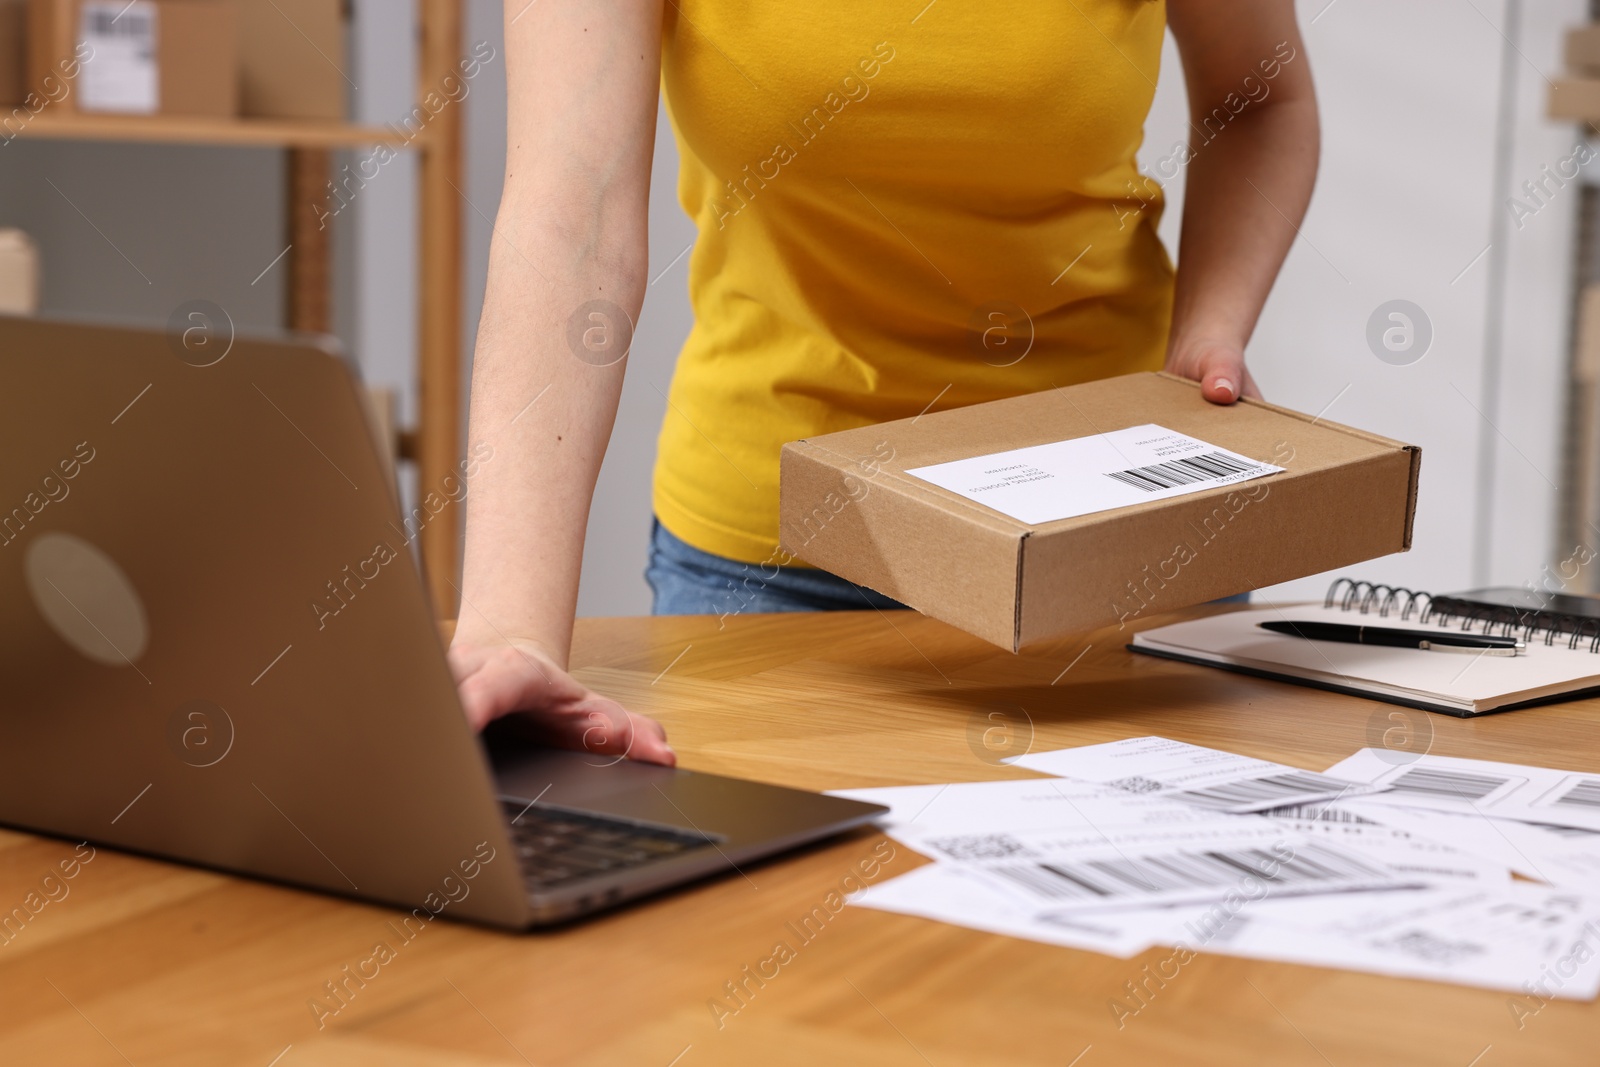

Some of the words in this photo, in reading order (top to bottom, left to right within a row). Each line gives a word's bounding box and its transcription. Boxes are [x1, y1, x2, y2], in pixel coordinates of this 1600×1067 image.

[1155, 449, 1182, 457] FROM
[1011, 473, 1055, 484] SHIPPING
[969, 481, 1010, 493] ADDRESS
